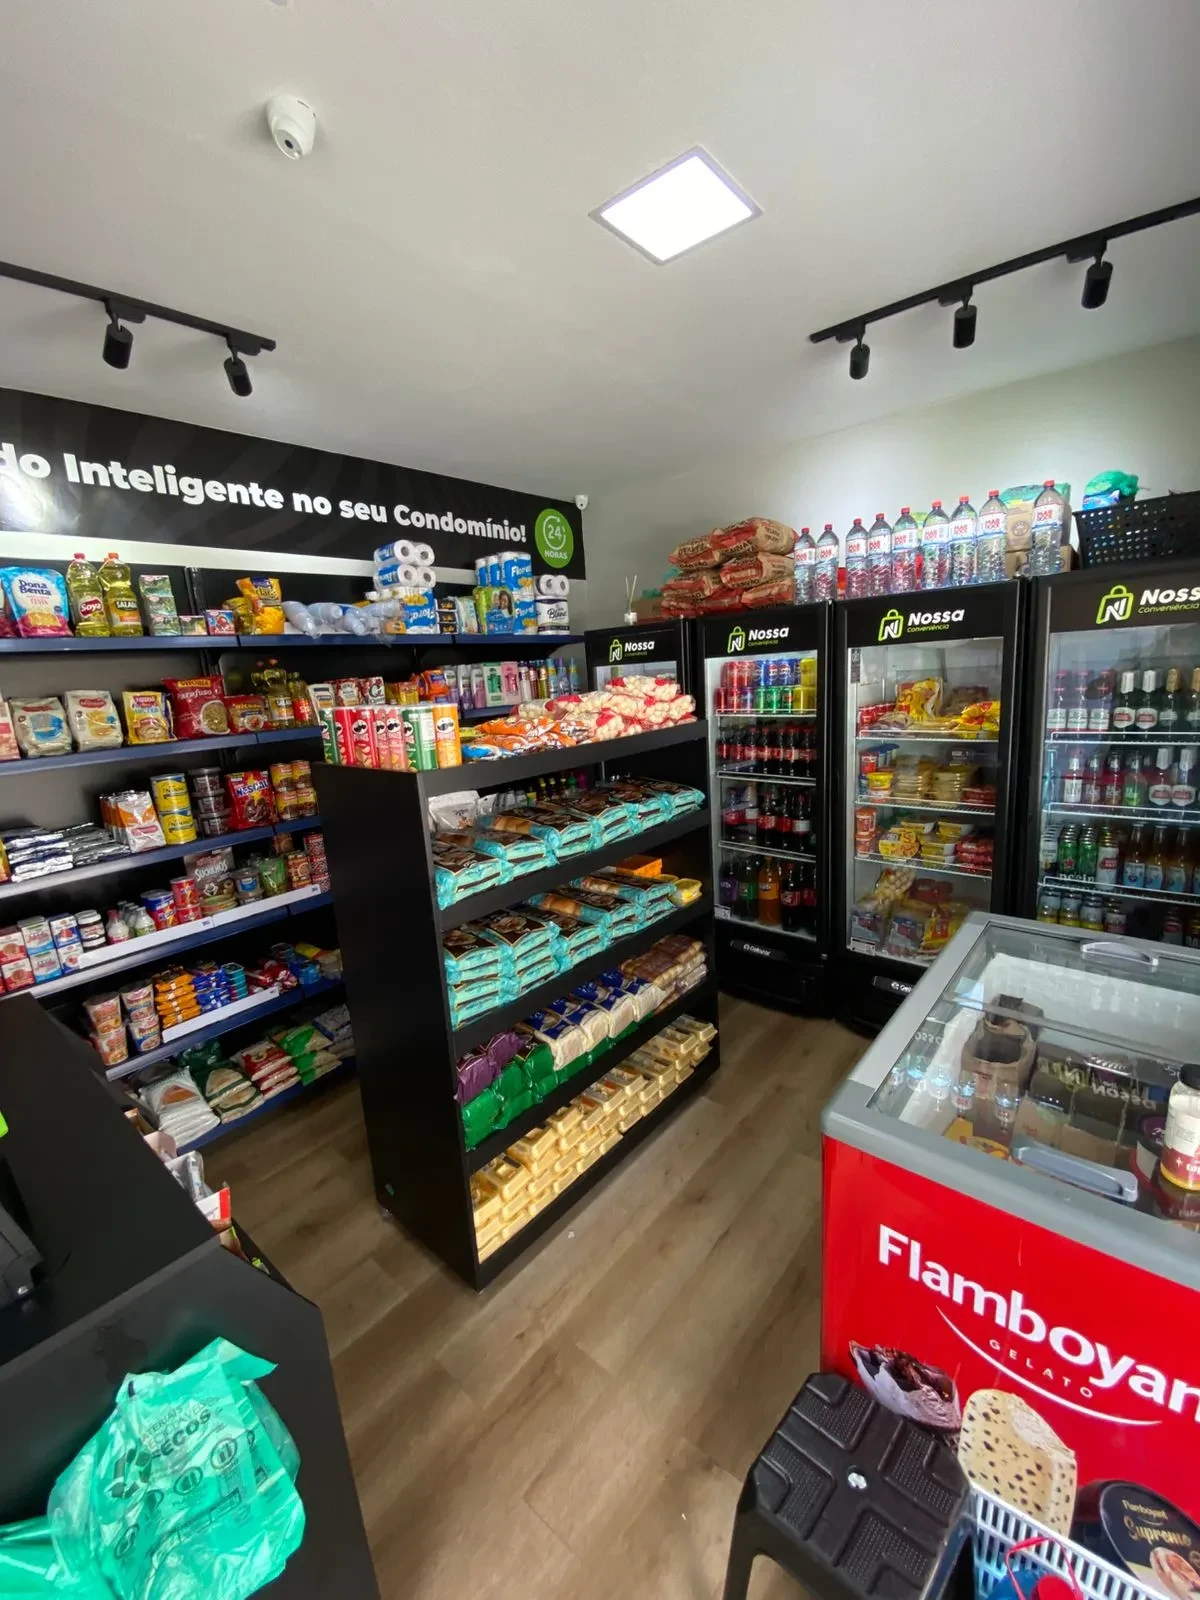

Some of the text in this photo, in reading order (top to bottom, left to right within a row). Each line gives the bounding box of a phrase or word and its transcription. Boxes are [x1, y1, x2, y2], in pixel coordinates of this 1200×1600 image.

[0, 442, 527, 544] do Inteligente no seu Condomínio!
[548, 524, 562, 541] 24
[544, 549, 568, 560] HORAS
[18, 579, 48, 590] Dona
[19, 586, 52, 597] Benta
[80, 601, 102, 613] Soya
[907, 609, 965, 627] Nossa
[748, 626, 789, 641] Nossa
[624, 640, 655, 652] Nossa
[988, 1338, 1094, 1399] GELATO
